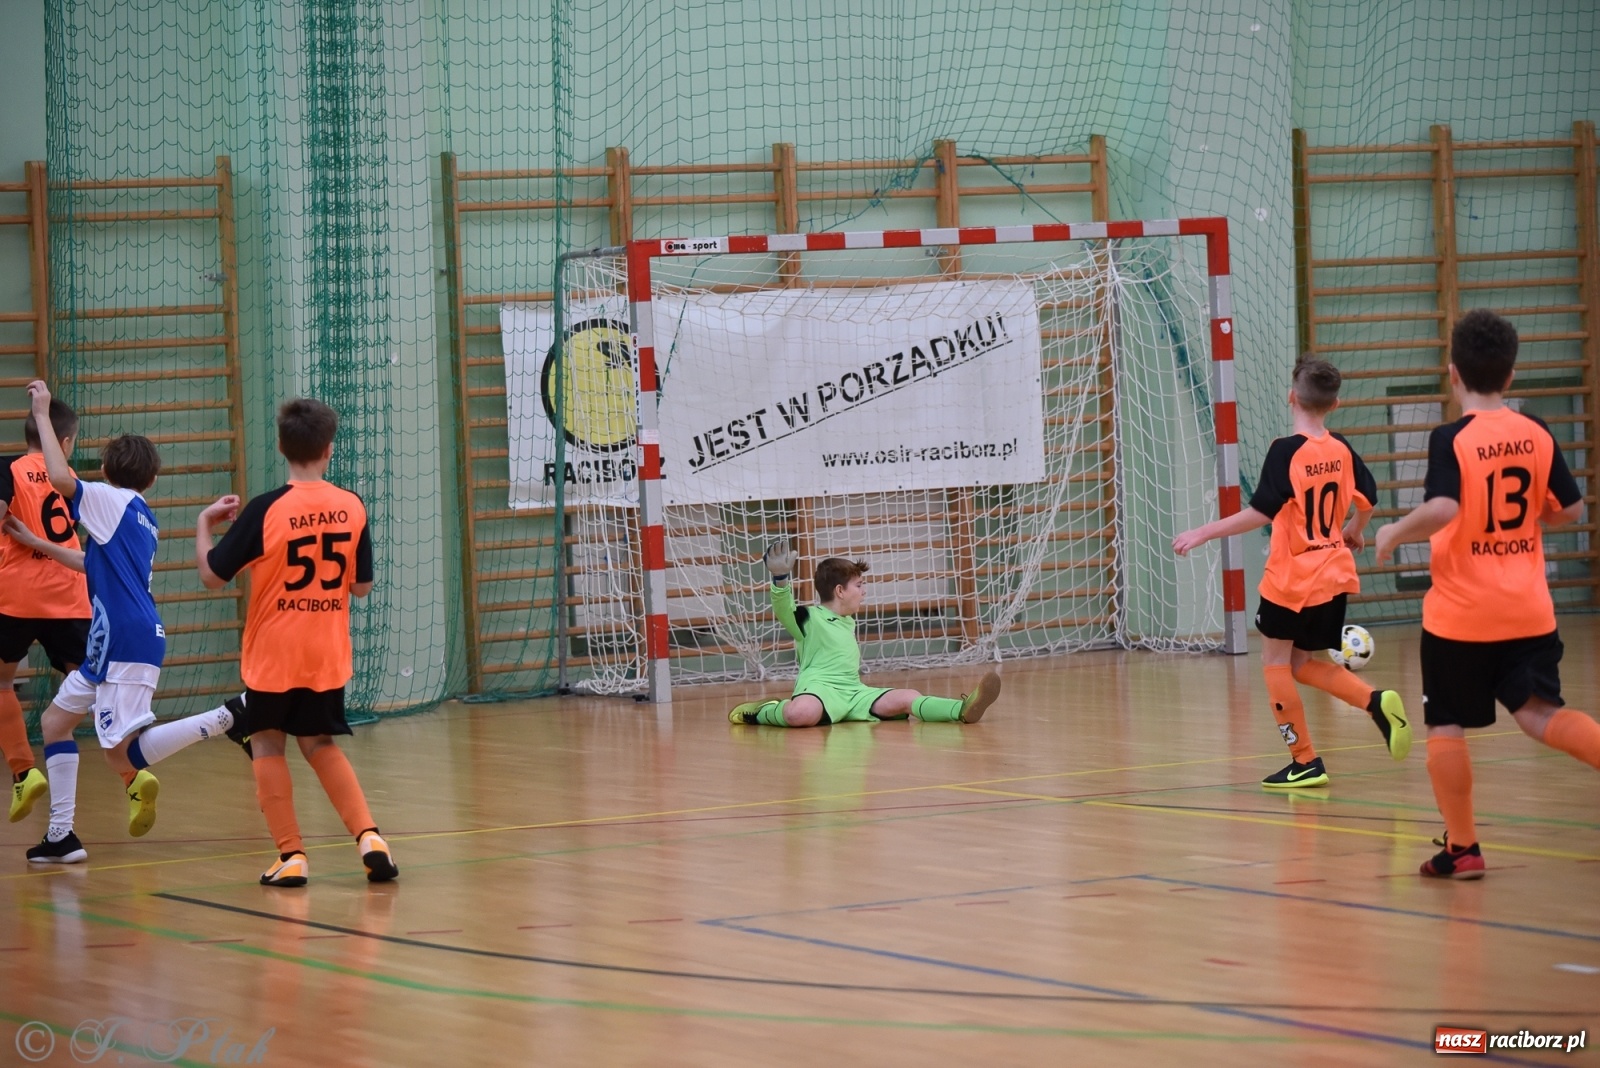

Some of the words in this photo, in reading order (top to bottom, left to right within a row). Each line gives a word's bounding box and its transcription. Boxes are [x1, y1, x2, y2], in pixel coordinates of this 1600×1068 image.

[693, 241, 717, 251] sport
[688, 408, 767, 468] JEST
[776, 392, 811, 430] W
[817, 311, 1009, 413] PORZĄDKU!
[822, 438, 1018, 468] www.osir-raciborz.pl
[1476, 439, 1534, 461] RAFAKO
[544, 457, 667, 486] RACIBO
[1305, 460, 1341, 477] RAFAKO
[1304, 481, 1338, 541] 10
[1484, 466, 1531, 533] 13
[41, 490, 75, 544] 6
[289, 510, 348, 531] RAFAKO
[284, 531, 352, 592] 55
